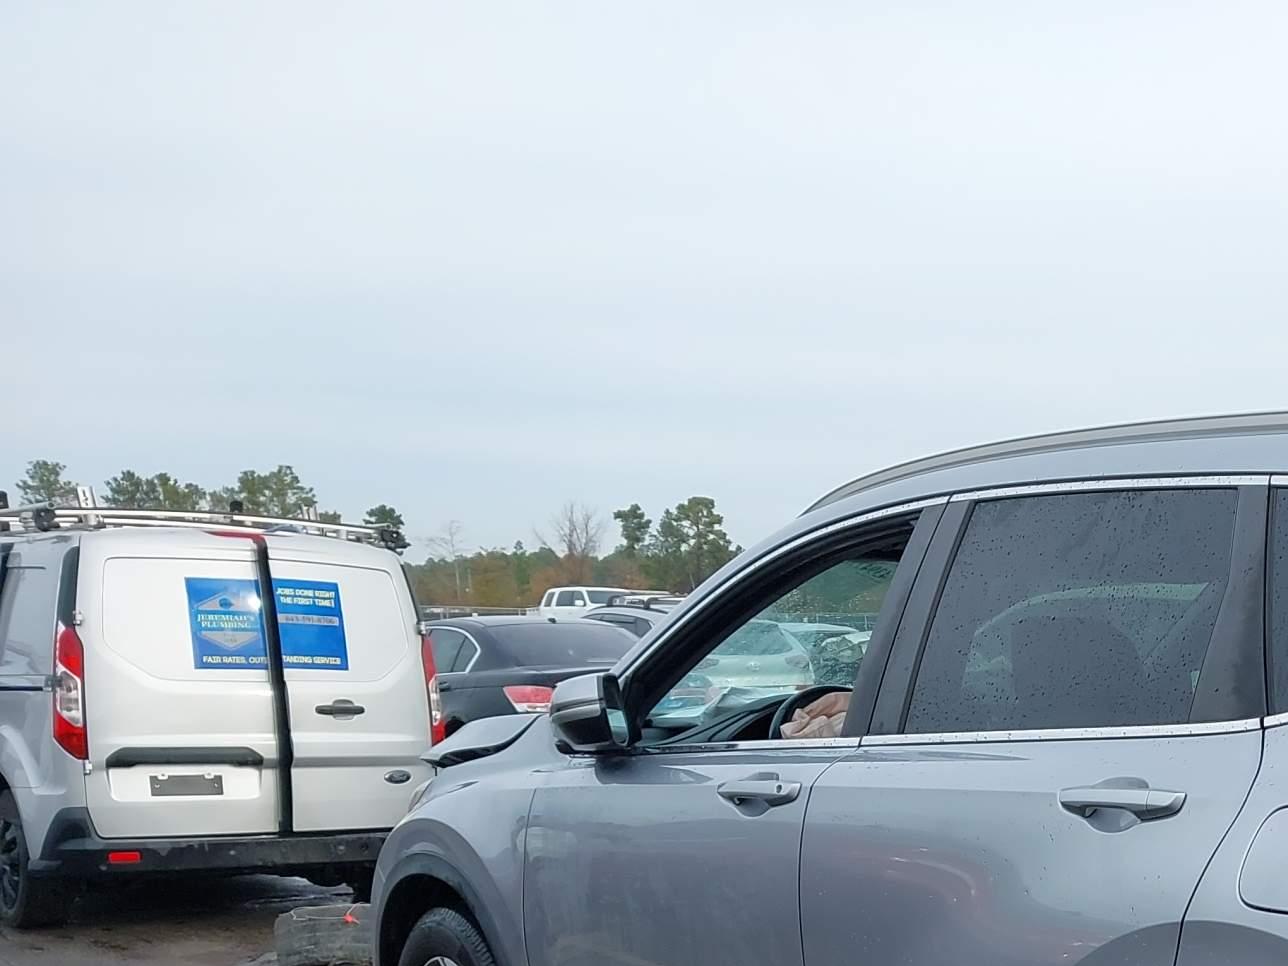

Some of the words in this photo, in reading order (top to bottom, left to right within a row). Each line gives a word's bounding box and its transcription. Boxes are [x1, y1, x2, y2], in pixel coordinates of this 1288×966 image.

[295, 588, 314, 597] DONE
[280, 596, 293, 604] THE
[201, 621, 249, 629] PLUMBING
[202, 655, 222, 664] FAIR
[313, 656, 341, 665] SERVICE
